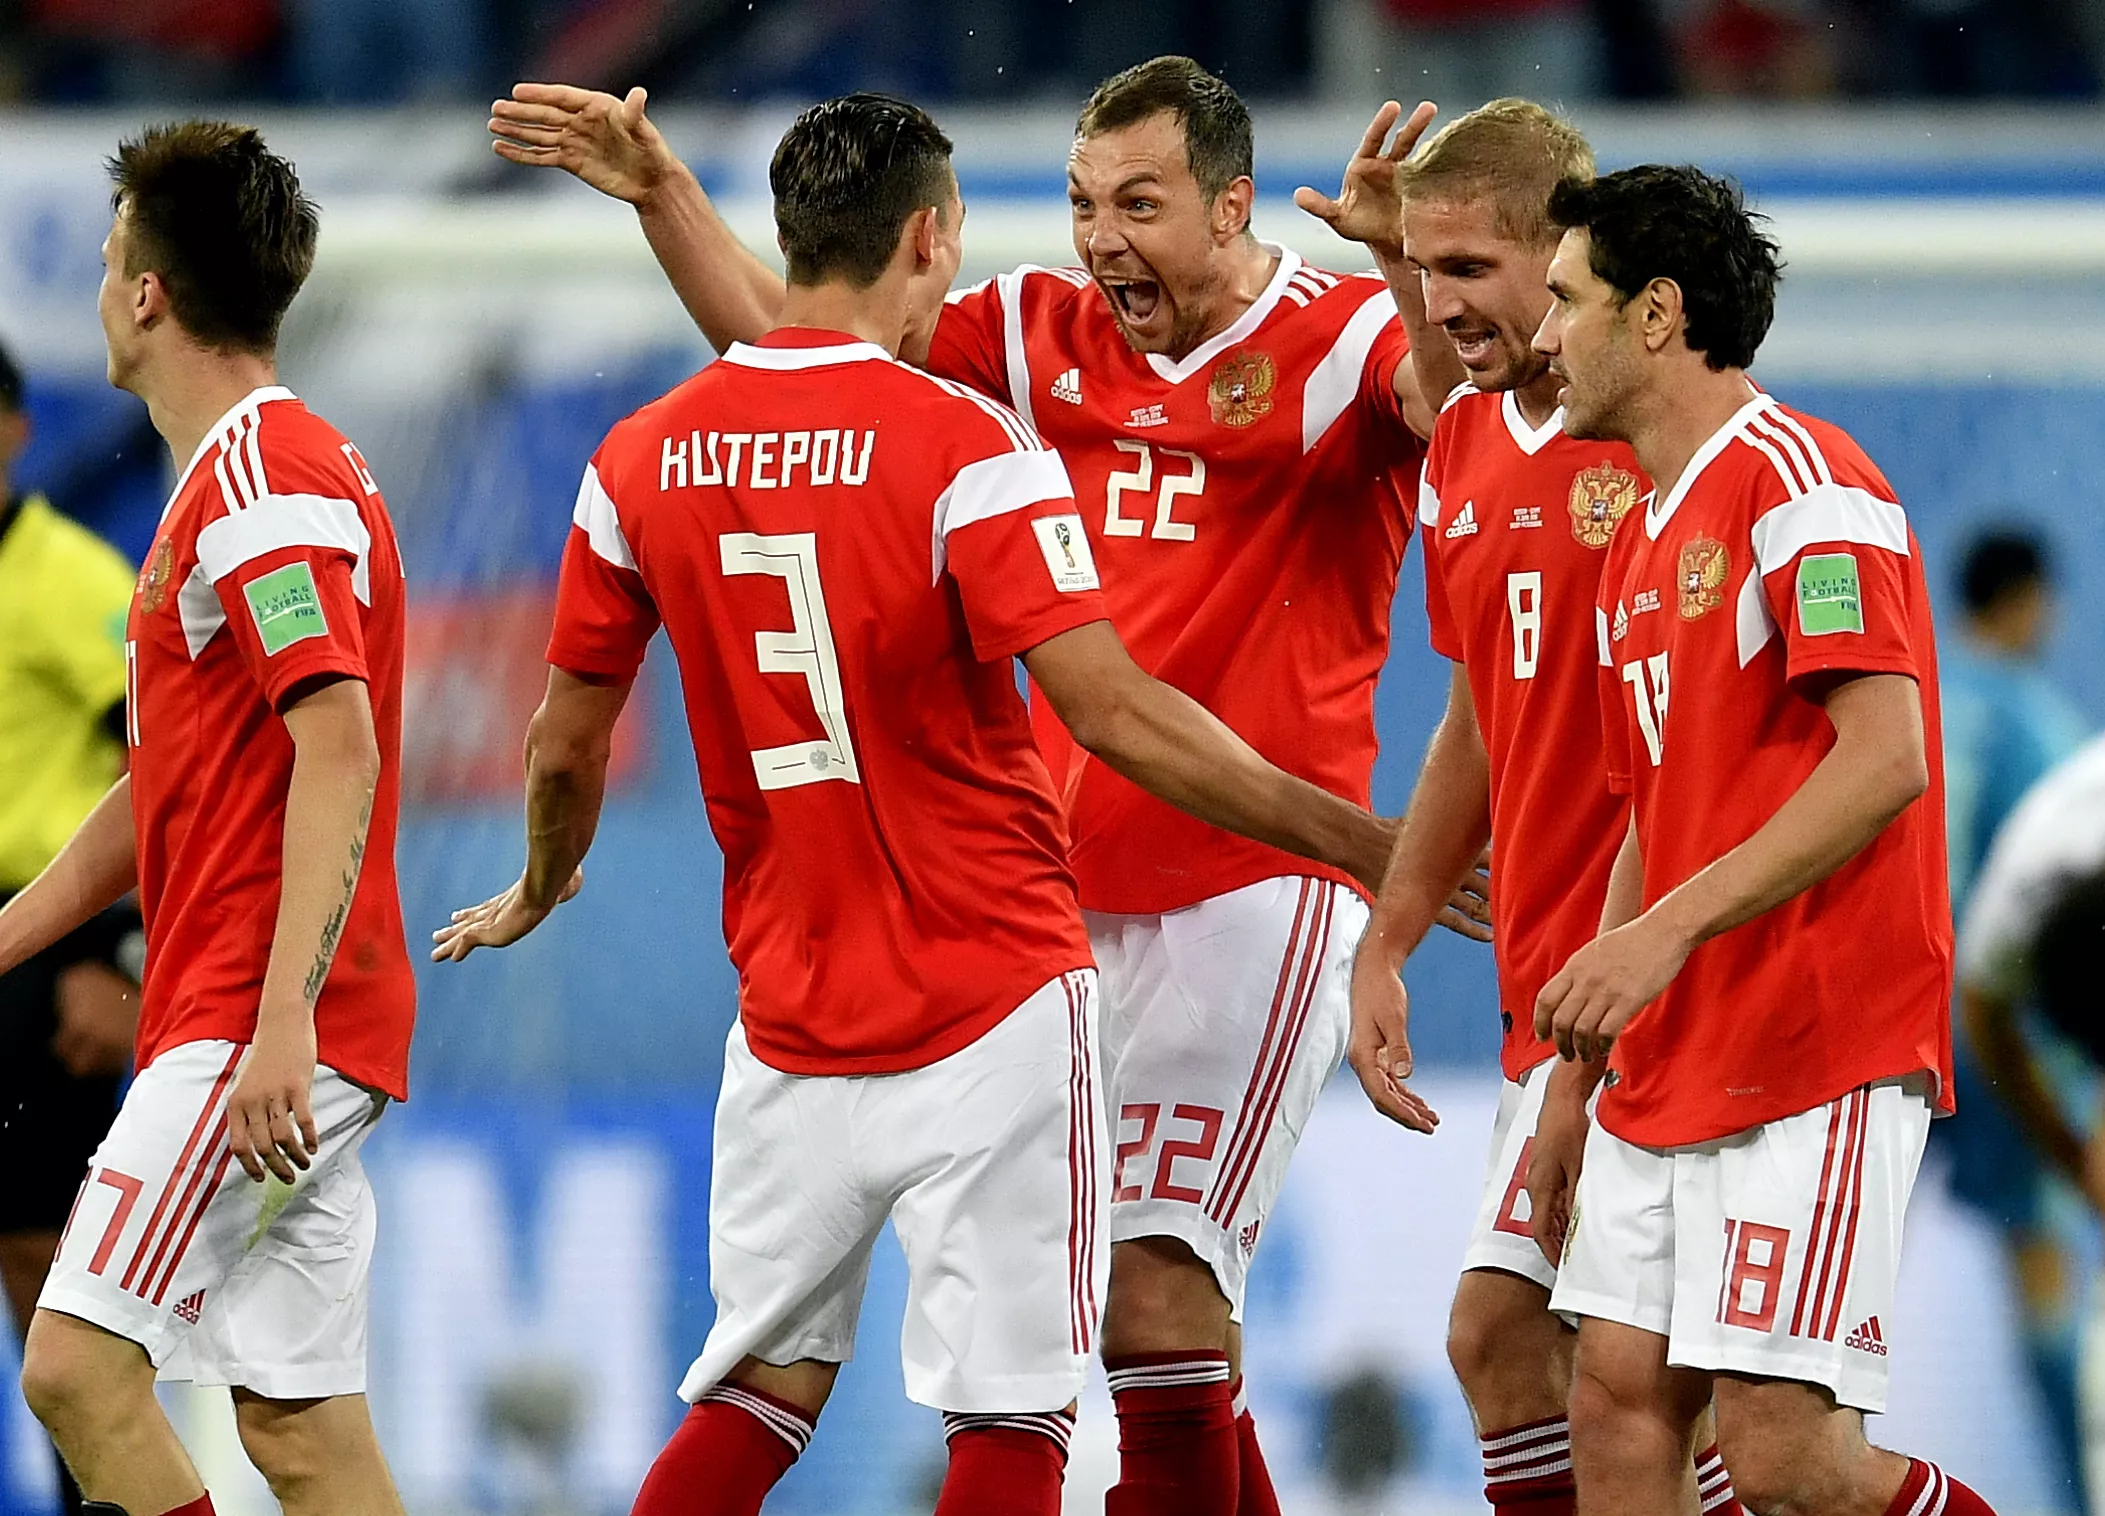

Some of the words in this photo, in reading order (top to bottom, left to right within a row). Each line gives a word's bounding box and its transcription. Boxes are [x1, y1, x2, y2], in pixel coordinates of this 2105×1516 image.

[1050, 386, 1083, 405] adidas
[660, 429, 876, 491] KUTEPOV
[1103, 438, 1206, 541] 22
[1445, 522, 1478, 539] adidas
[256, 585, 309, 611] LIVING
[1802, 577, 1857, 589] LIVING
[1507, 571, 1542, 680] 8
[718, 532, 861, 791] 3
[1110, 1102, 1225, 1205] 22
[1715, 1217, 1791, 1334] 18
[1844, 1335, 1888, 1356] adidas
